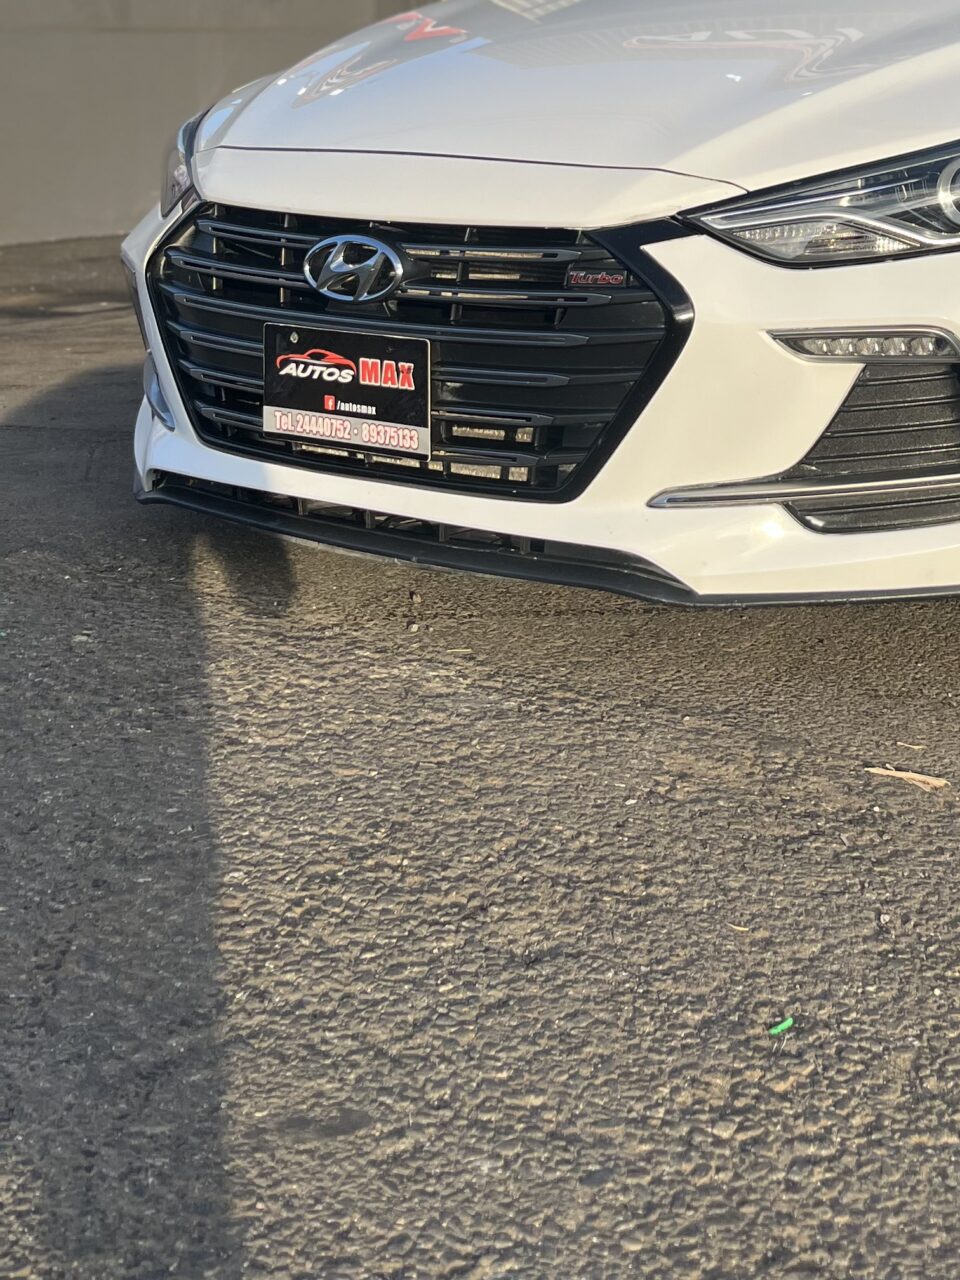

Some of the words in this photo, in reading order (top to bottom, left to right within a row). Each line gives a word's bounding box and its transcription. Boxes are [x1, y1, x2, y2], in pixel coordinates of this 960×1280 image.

[570, 271, 623, 284] Turbo
[279, 363, 354, 383] AUTOS
[359, 358, 415, 390] MAX
[296, 414, 351, 440] 24440752
[361, 422, 419, 451] 89375133
